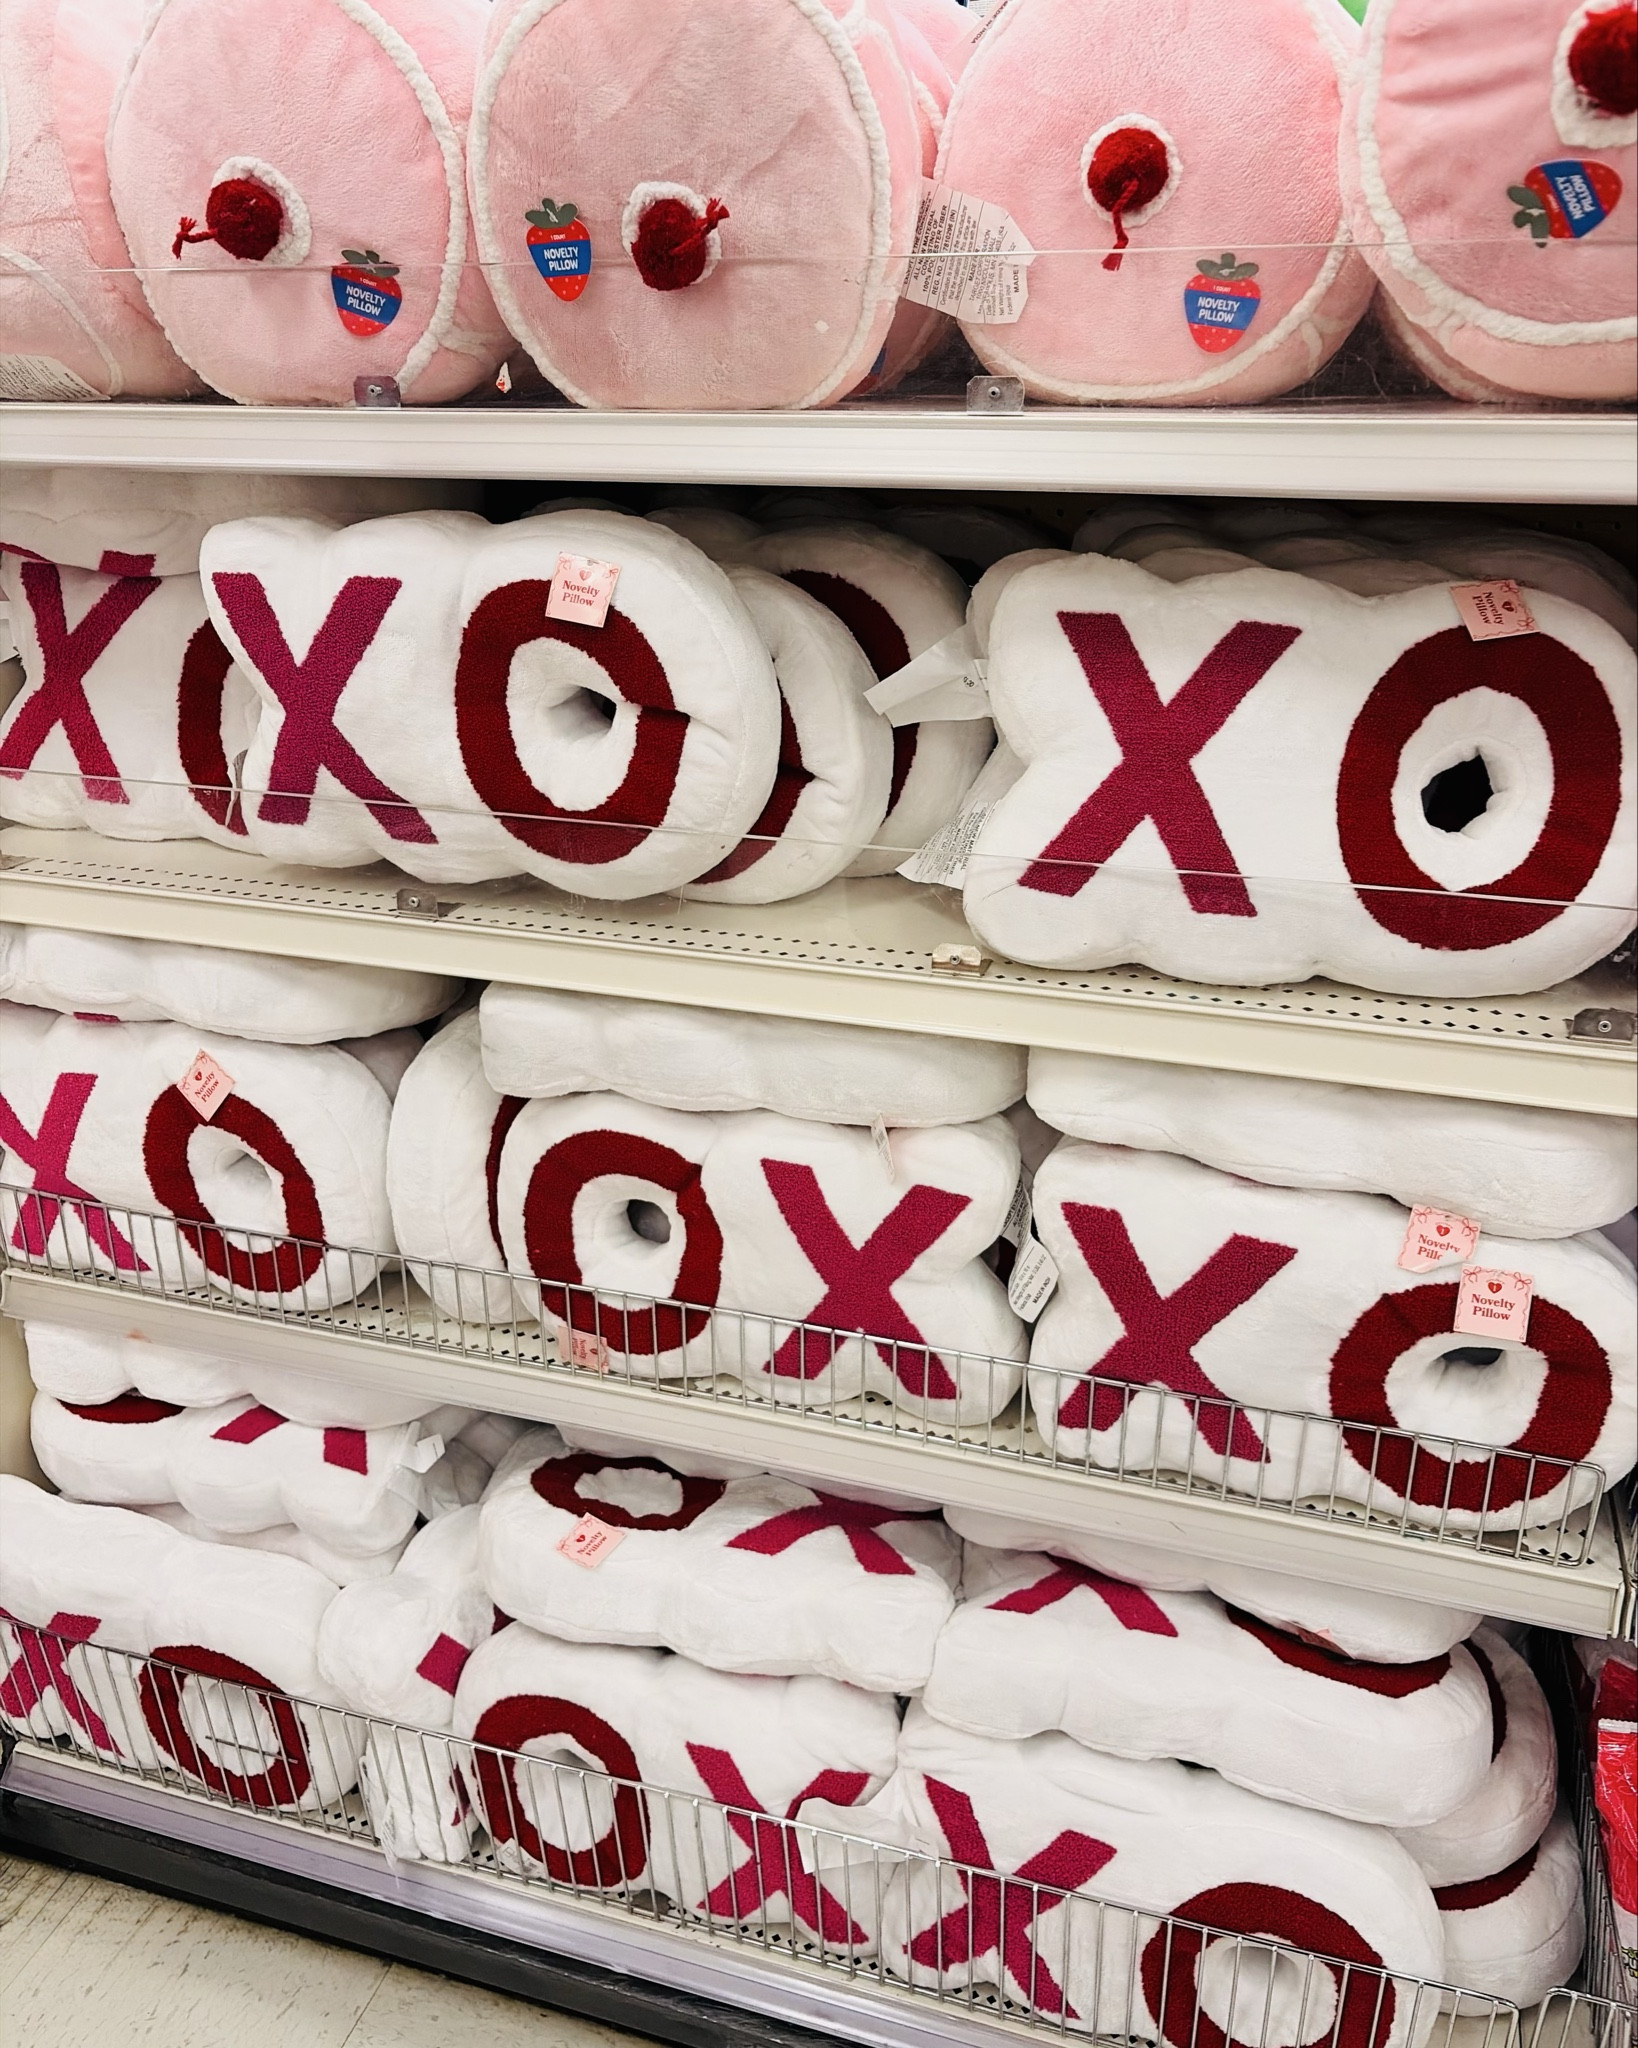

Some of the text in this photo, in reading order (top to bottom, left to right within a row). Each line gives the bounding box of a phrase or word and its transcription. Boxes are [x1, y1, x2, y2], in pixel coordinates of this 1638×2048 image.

[1555, 176, 1585, 220] NOVELTY
[1569, 174, 1596, 213] PILLOW
[544, 246, 578, 260] NOVELTY
[913, 265, 921, 280] ALL
[918, 247, 927, 265] NW
[923, 208, 936, 246] MATERIAL
[920, 218, 939, 276] CONSTING OF
[923, 204, 948, 292] 100% POLESTER FIBER
[976, 229, 992, 276] CORPRATION
[548, 259, 578, 272] PILLOW
[981, 253, 993, 285] NICOLLE
[346, 285, 386, 307] NOVELTY
[347, 297, 381, 316] PILLOW
[1198, 296, 1240, 312] NOVELTY
[1198, 308, 1234, 323] PILLOW
[562, 580, 600, 598] Novelty
[562, 592, 594, 606] Pillow
[1472, 595, 1492, 625] Pillow
[1482, 591, 1504, 625] Novelty
[961, 840, 974, 871] MATRIAL
[194, 1072, 215, 1098] Novelty
[201, 1080, 219, 1103] Pillow
[1471, 1294, 1516, 1312] Novelty
[1472, 1306, 1511, 1321] Pillow
[577, 1531, 602, 1554] Novelty
[586, 1536, 607, 1556] Pillow
